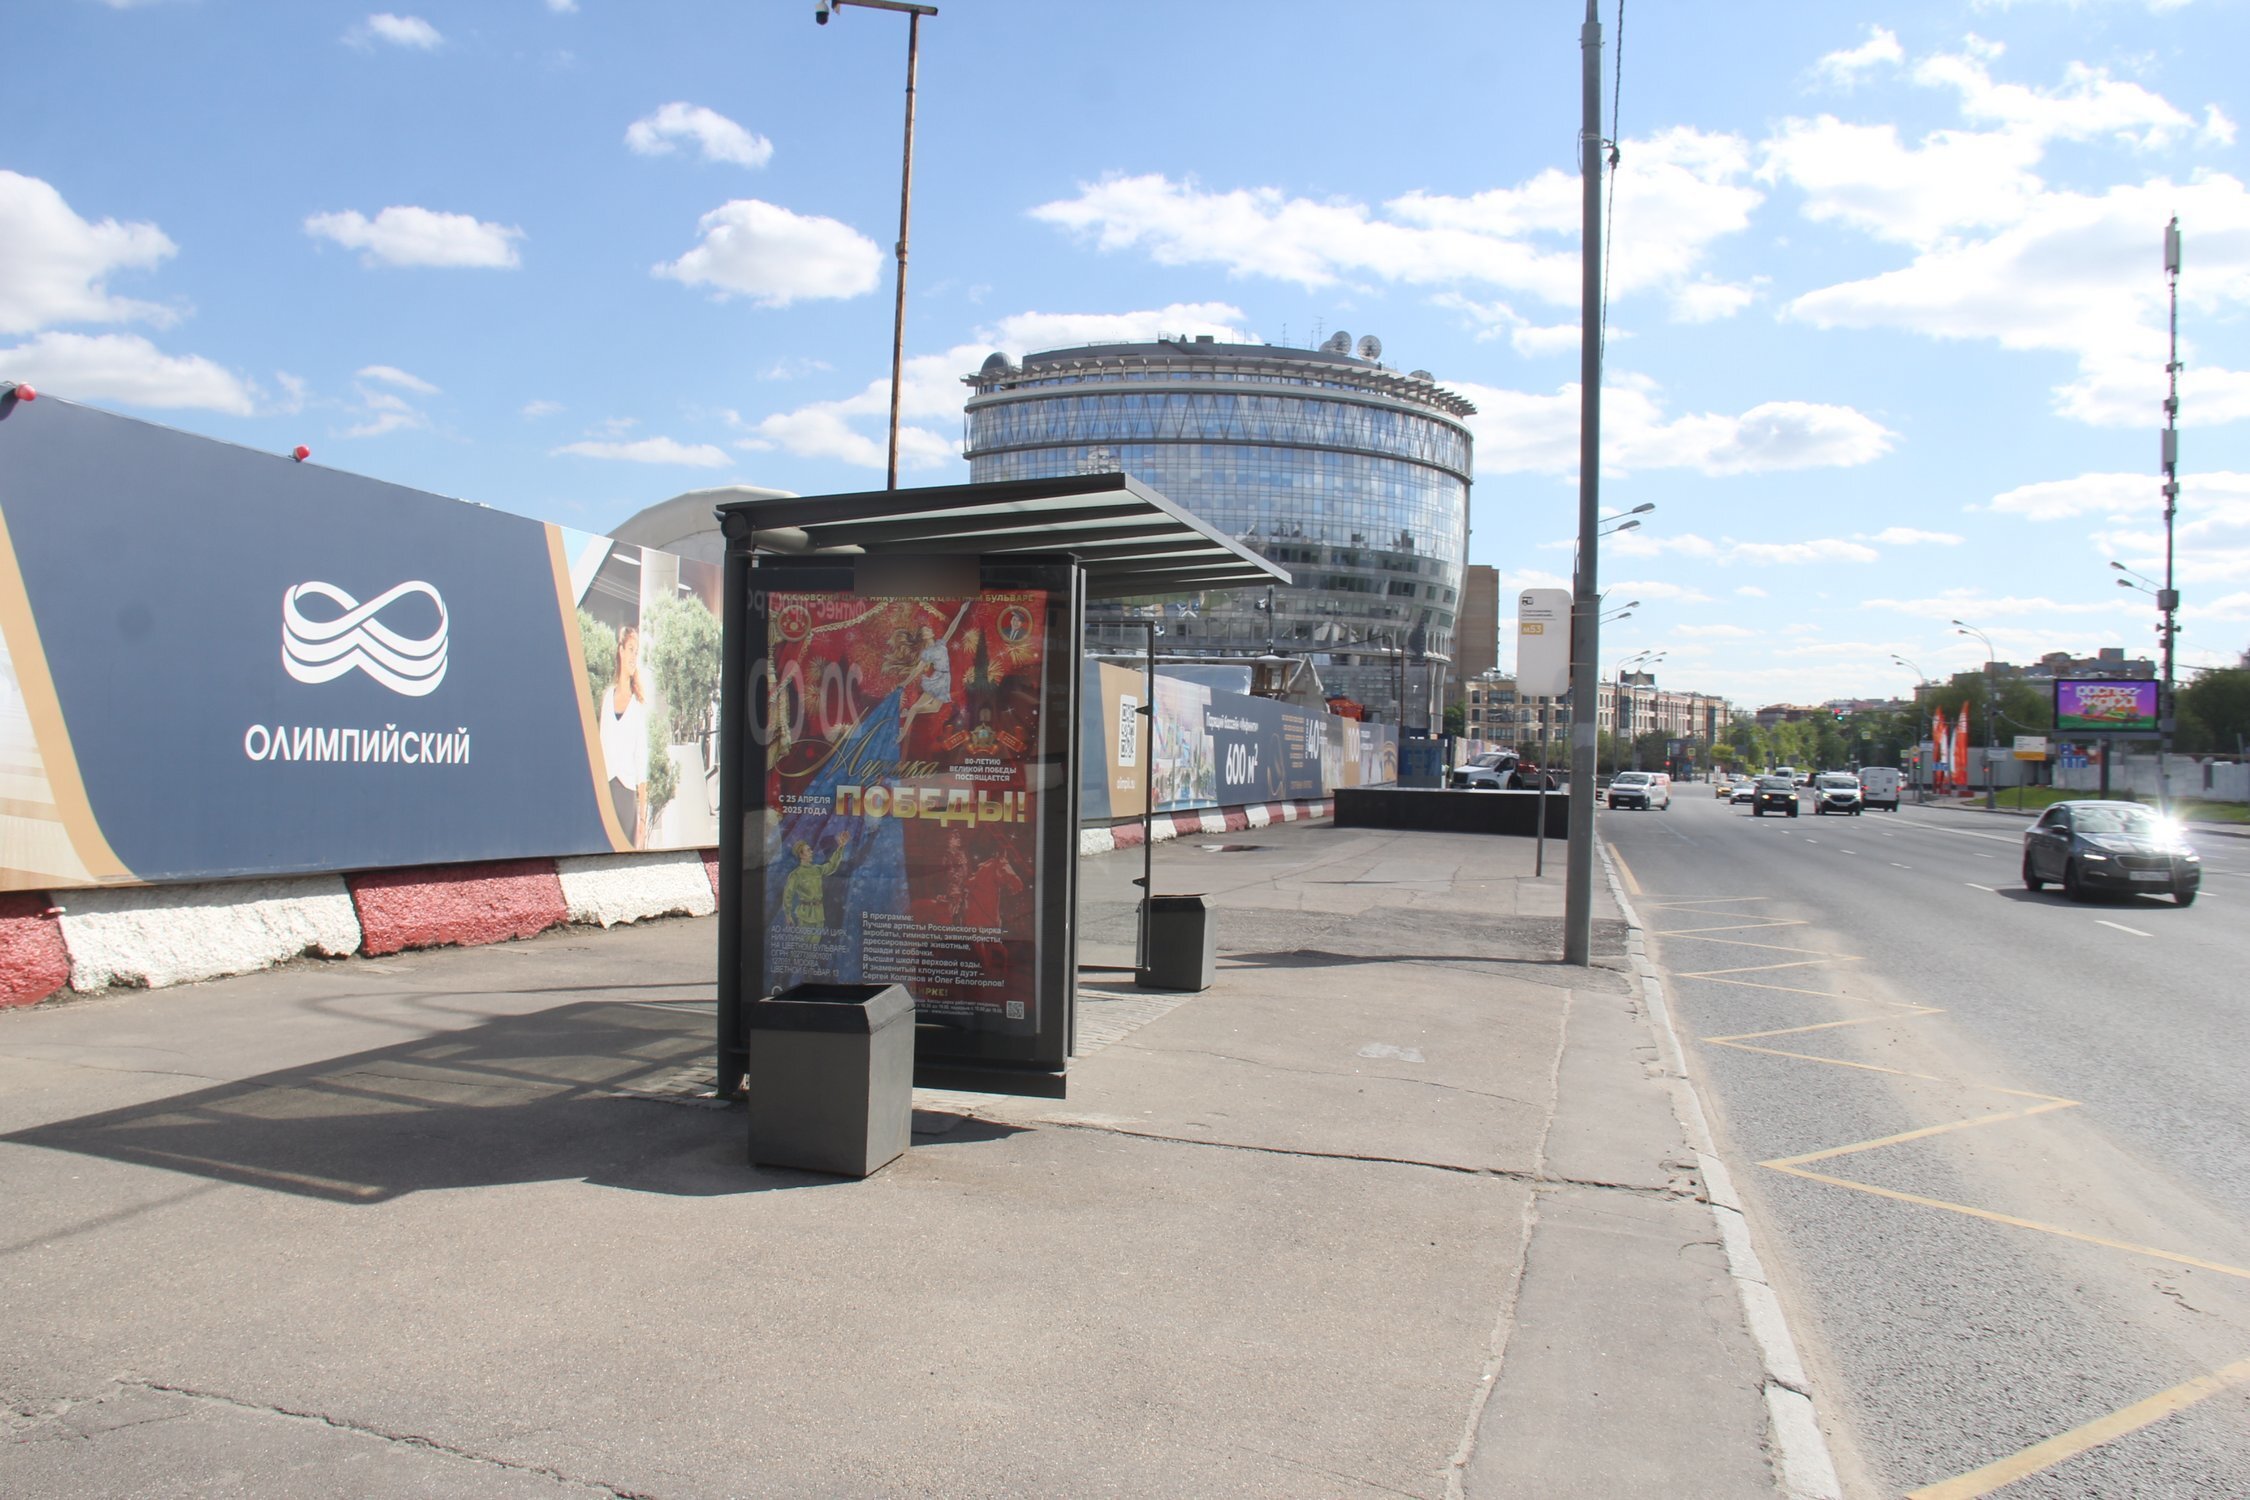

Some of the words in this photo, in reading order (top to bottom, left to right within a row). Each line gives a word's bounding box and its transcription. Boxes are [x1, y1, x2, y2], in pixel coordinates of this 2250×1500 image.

[244, 722, 470, 765] ОЛИМПИЙСКИЙ
[949, 765, 984, 773] ВЕЛИКОЙ
[984, 766, 1017, 775] ПОБЕДЫ
[955, 774, 1010, 782] ПОСВЯЩАЕТСЯ
[778, 795, 784, 803] С
[786, 795, 797, 803] 25
[797, 795, 831, 805] АПРЕЛЯ
[782, 806, 802, 815] 2025
[803, 806, 828, 816] ГОДА
[835, 785, 1026, 829] ПОБЕДЫ!
[863, 911, 869, 919] В
[870, 913, 914, 922] программе:
[862, 920, 893, 930] Лучшие
[893, 924, 927, 932] артисты
[927, 924, 977, 934] Российского
[863, 938, 929, 948] дрессированные
[930, 943, 972, 951] животные,
[863, 947, 894, 955] лошади
[863, 954, 894, 963] Высшая
[895, 957, 920, 965] школа
[921, 959, 958, 968] верховой
[869, 964, 916, 973] знаменитый
[917, 967, 959, 976] клоунский
[959, 970, 978, 978] дуэт
[862, 971, 889, 981] Сергей
[890, 972, 926, 982] Колганов
[934, 977, 953, 985] Олег
